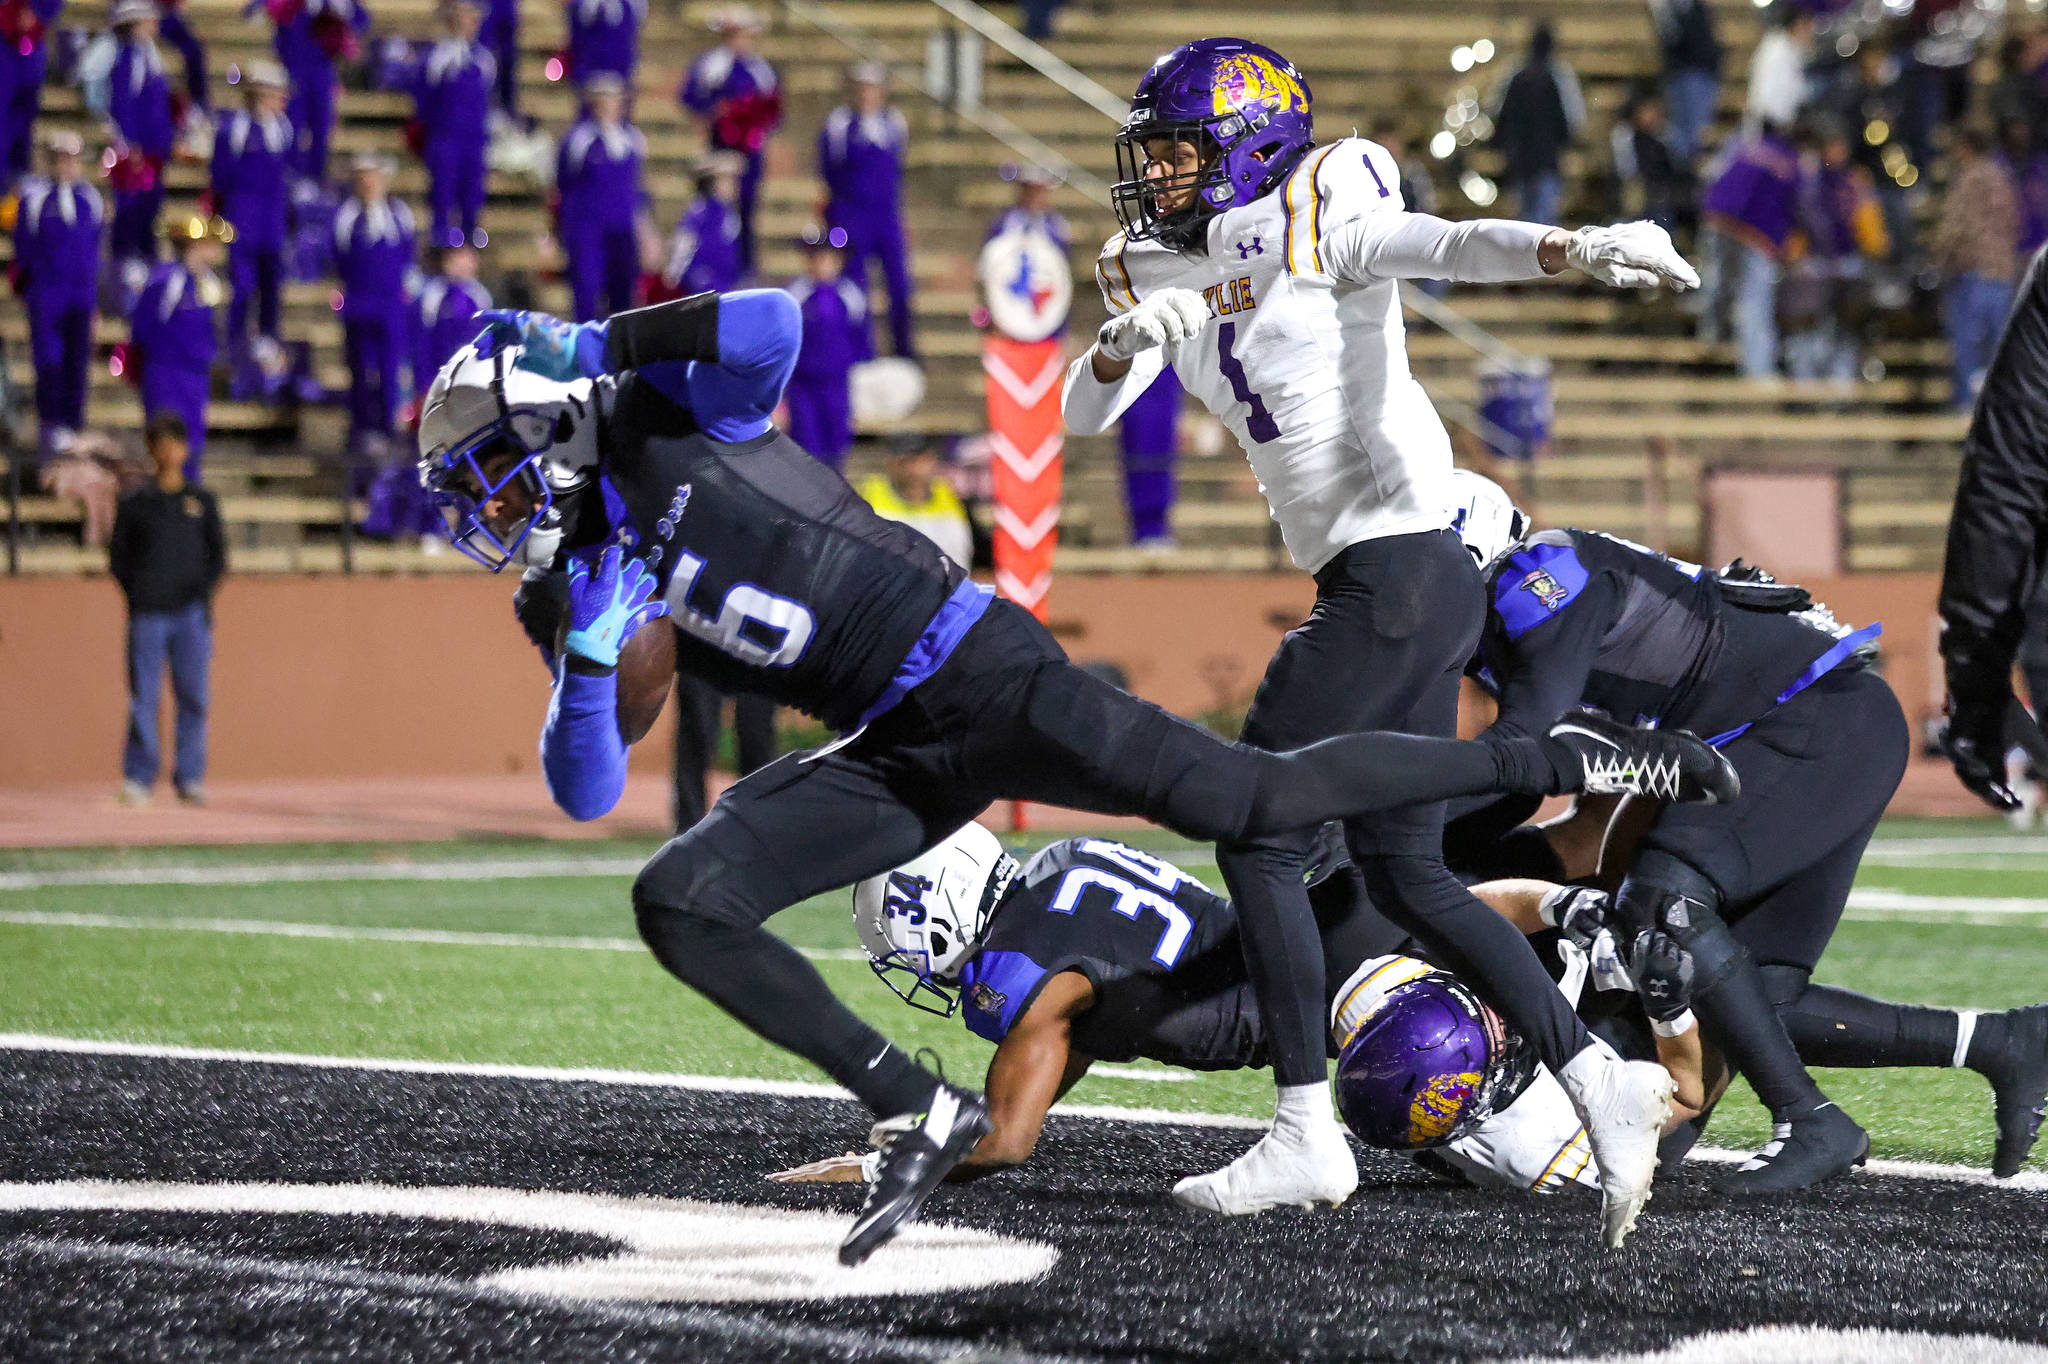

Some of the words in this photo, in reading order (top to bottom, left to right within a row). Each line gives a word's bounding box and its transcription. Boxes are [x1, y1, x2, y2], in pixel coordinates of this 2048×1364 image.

[1362, 153, 1391, 198] 1
[1203, 276, 1256, 320] YLIE
[1218, 321, 1282, 444] 1
[664, 546, 819, 668] 6
[886, 870, 934, 925] 34
[1048, 837, 1214, 970] 34
